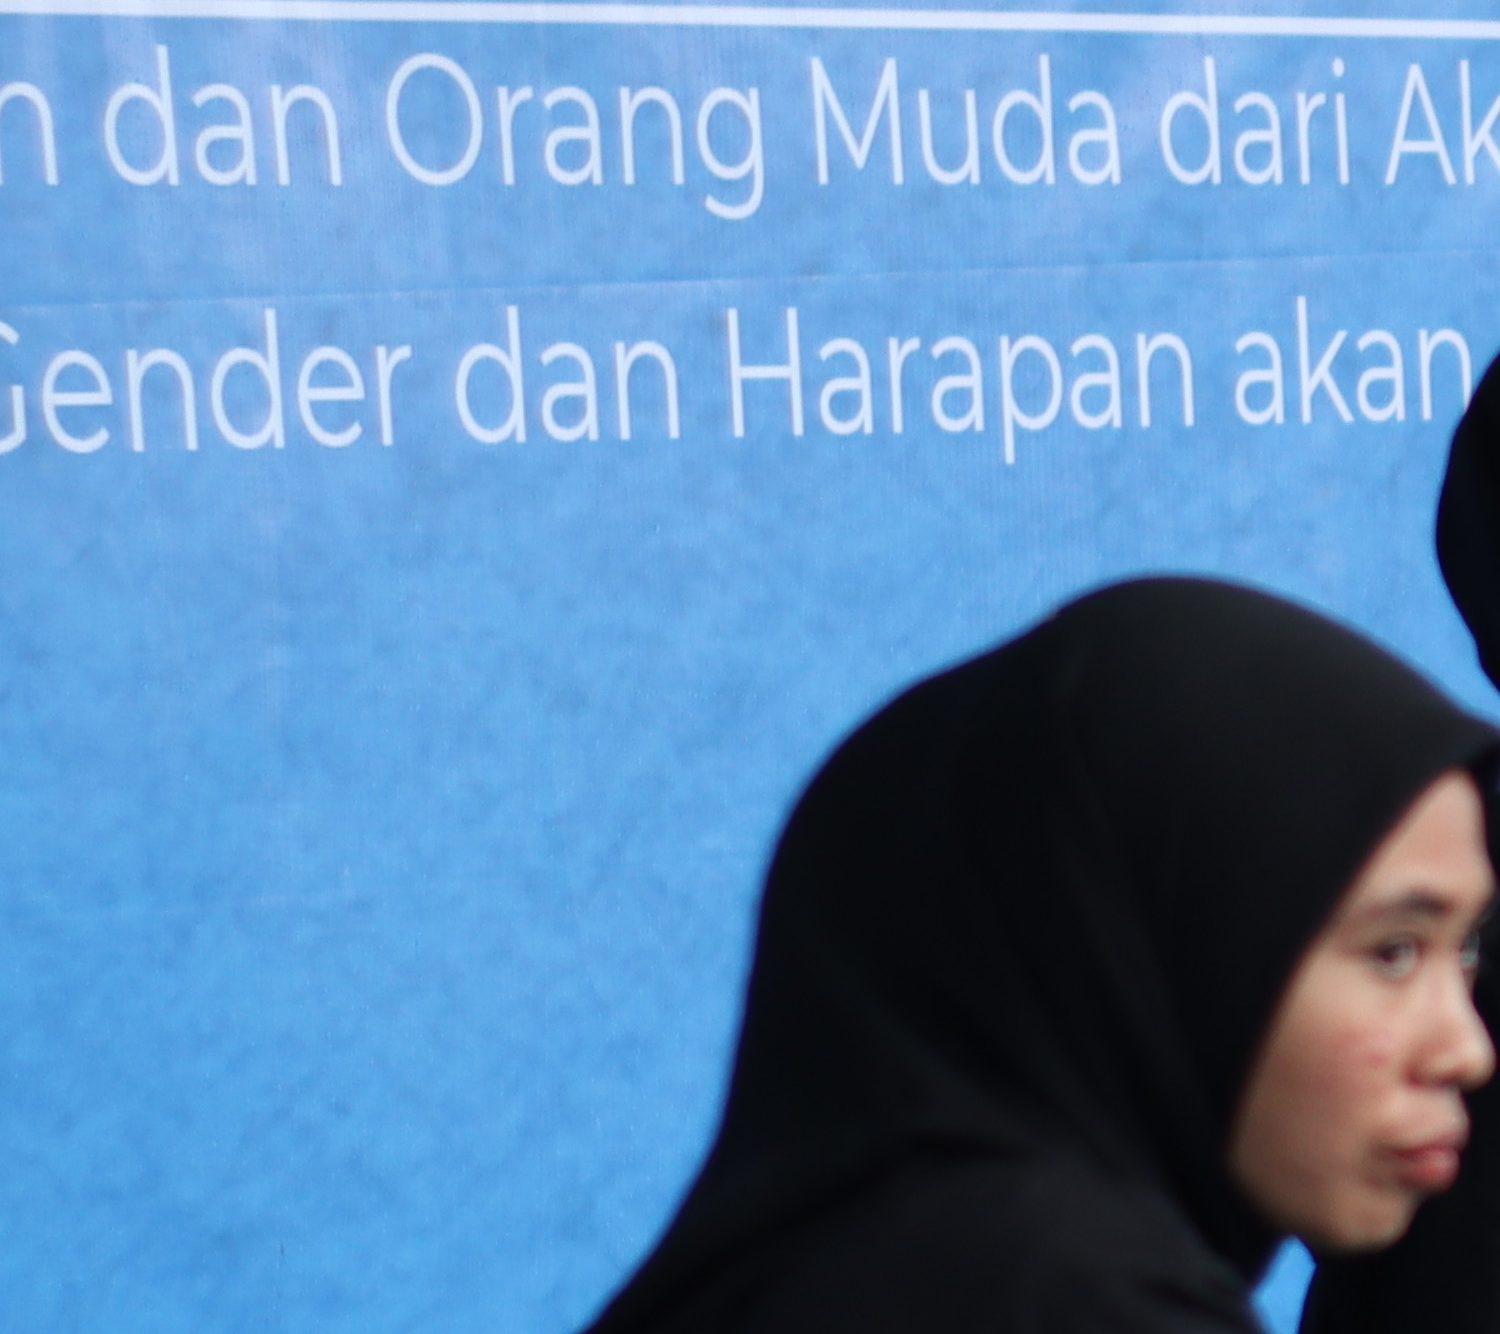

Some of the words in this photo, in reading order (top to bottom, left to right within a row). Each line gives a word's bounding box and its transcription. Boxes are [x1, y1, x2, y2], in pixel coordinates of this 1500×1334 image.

[103, 44, 343, 186] dan
[385, 53, 765, 220] Orang
[810, 54, 1122, 186] Muda
[1158, 54, 1350, 186] dari
[454, 305, 680, 444] dan
[726, 306, 1195, 465] Harapan
[1234, 295, 1473, 425] akan
